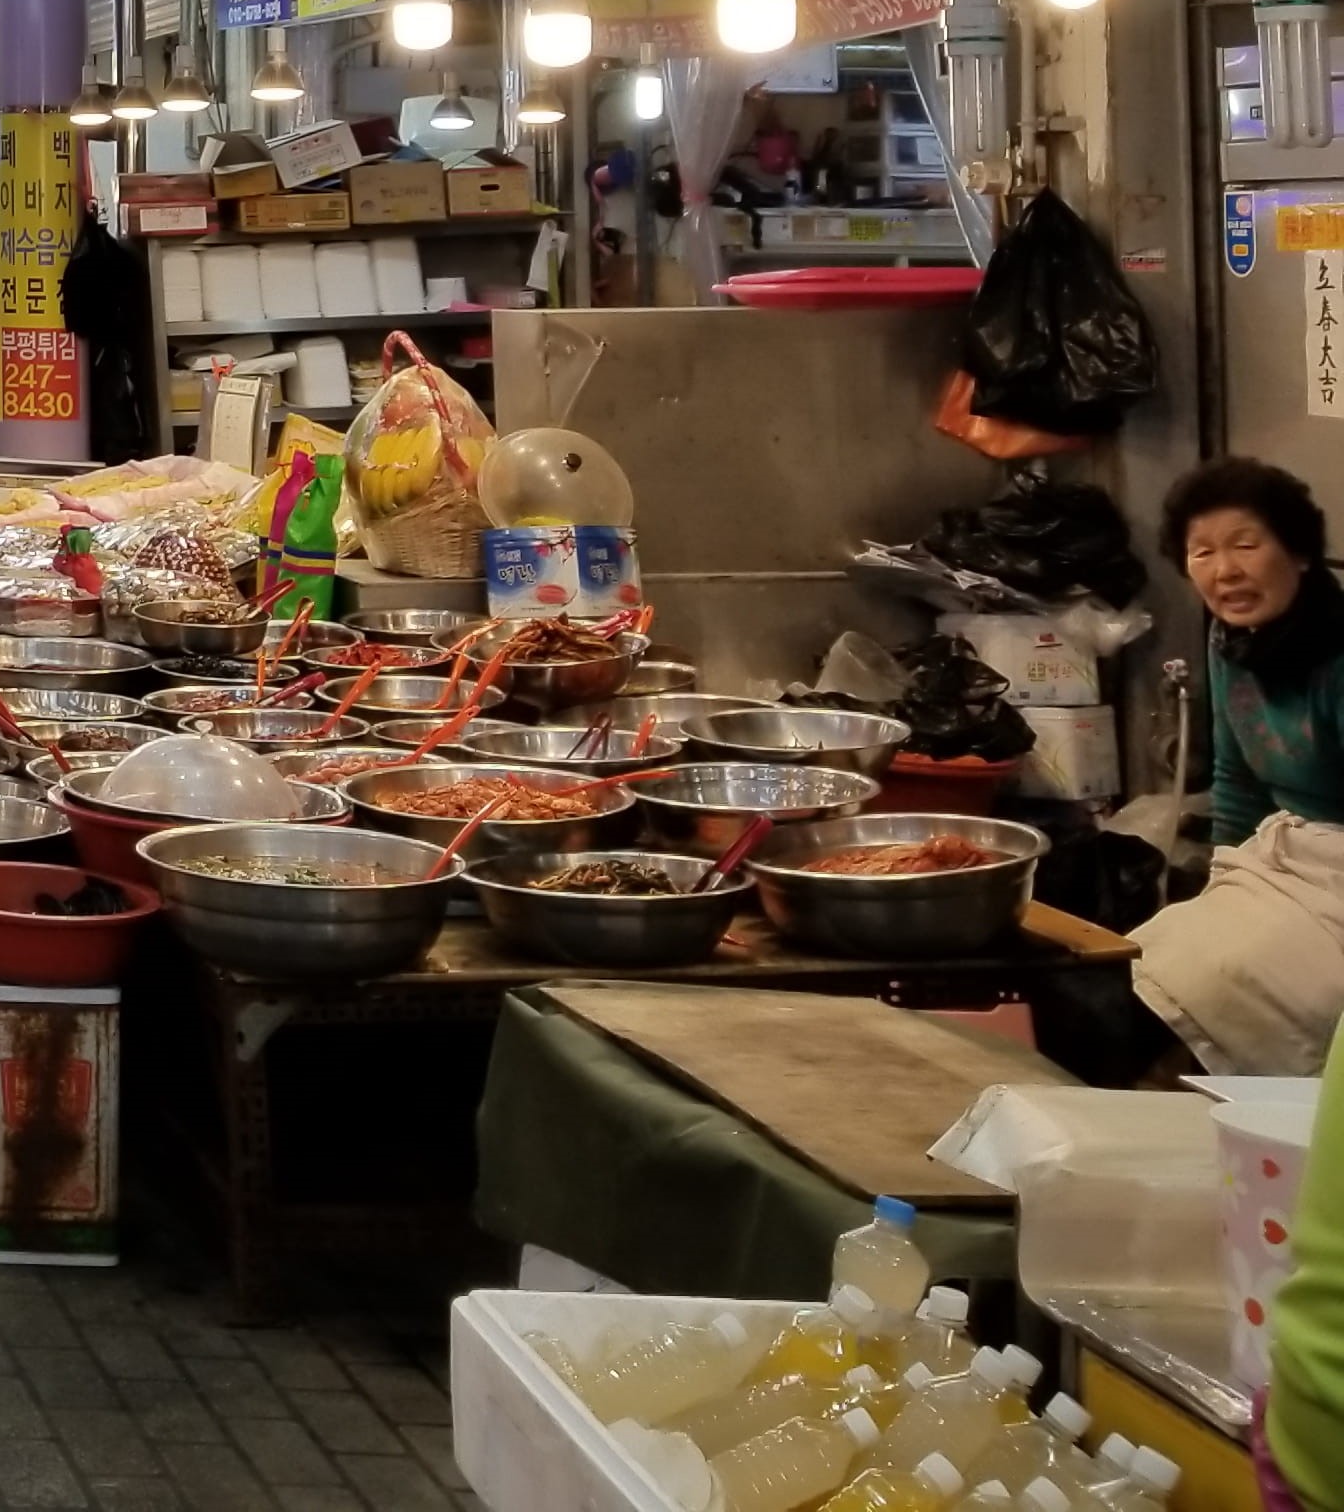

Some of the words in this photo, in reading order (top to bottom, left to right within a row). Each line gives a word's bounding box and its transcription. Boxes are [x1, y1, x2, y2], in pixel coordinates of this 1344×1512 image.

[0, 277, 65, 315] 전문
[1, 330, 77, 362] 부평튀김
[1314, 257, 1339, 407] 立春大吉
[3, 391, 74, 418] 8430
